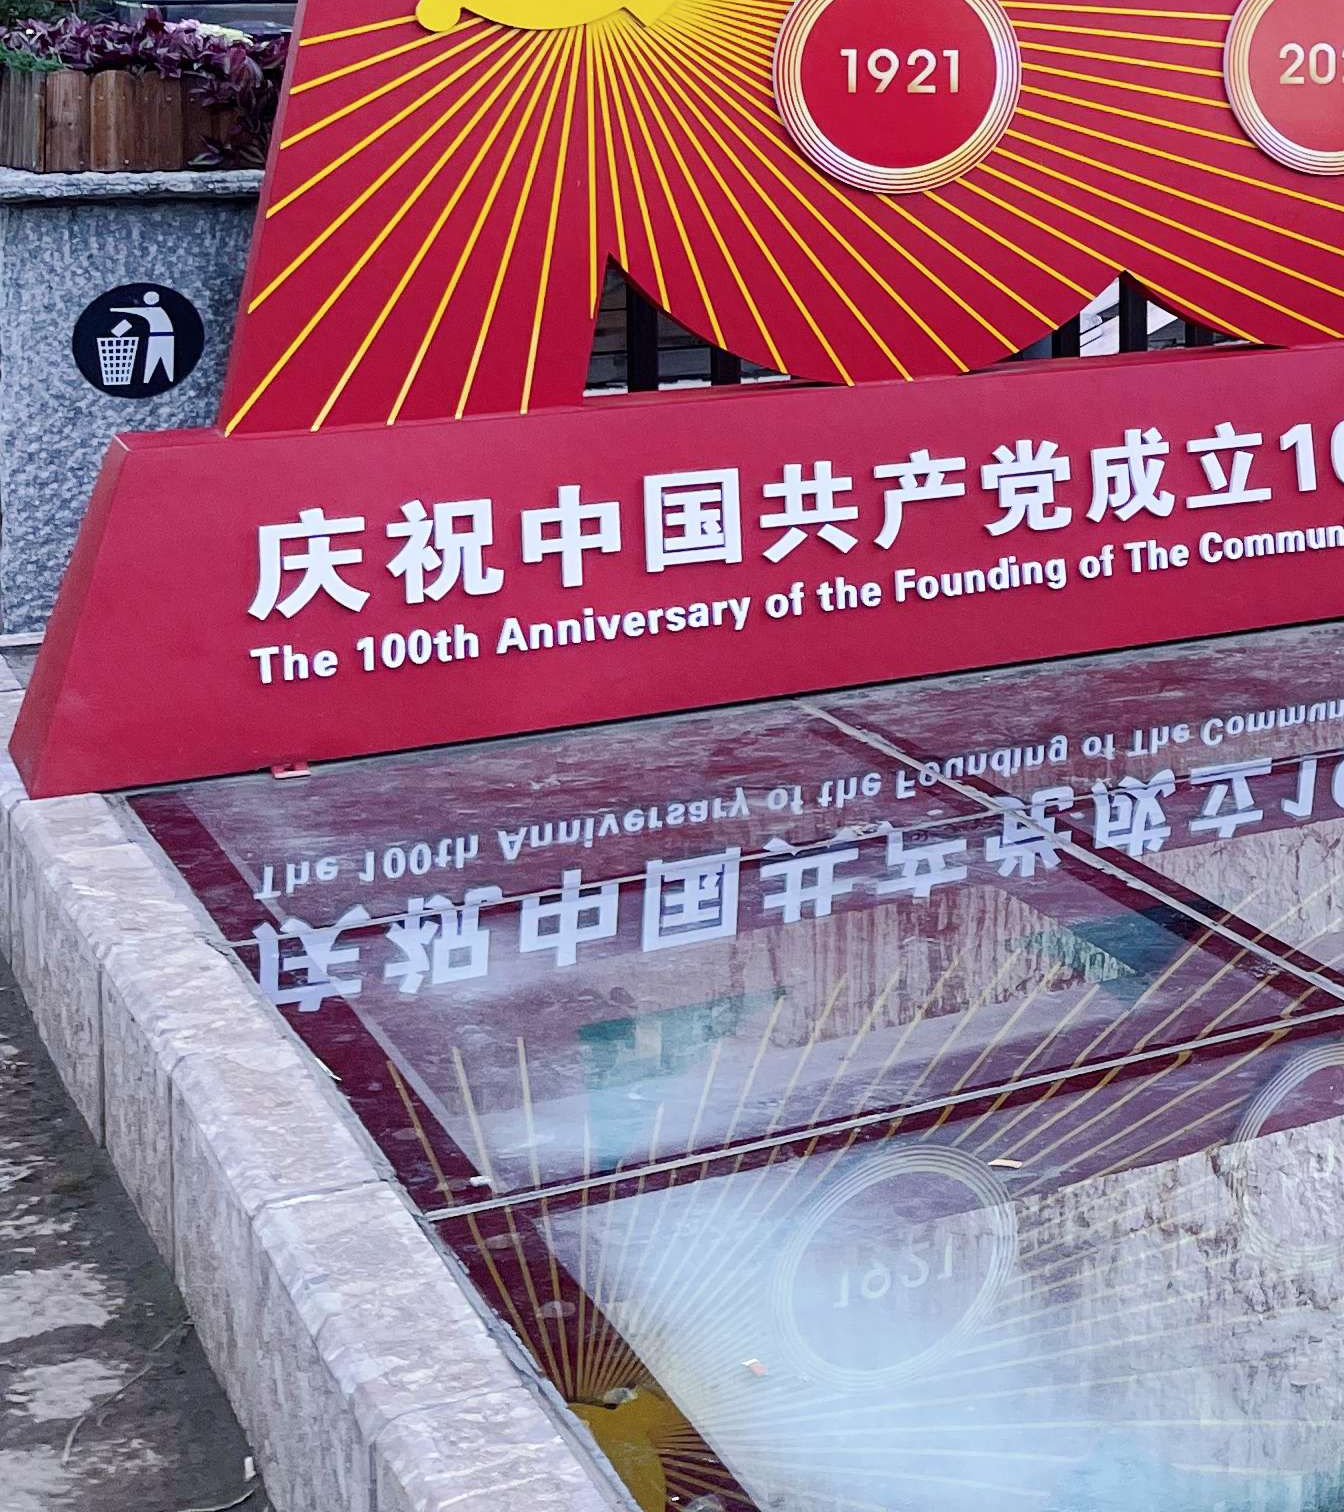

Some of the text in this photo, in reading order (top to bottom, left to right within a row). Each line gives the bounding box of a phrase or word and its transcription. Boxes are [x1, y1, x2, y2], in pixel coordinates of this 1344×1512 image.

[840, 48, 960, 93] 1921
[250, 644, 338, 684] The
[356, 623, 480, 672] 100th
[497, 596, 751, 653] Anniversary
[765, 581, 805, 619] of
[816, 576, 882, 612] the
[894, 555, 1067, 602] Founding
[1079, 544, 1115, 579] of
[1123, 538, 1190, 573] The
